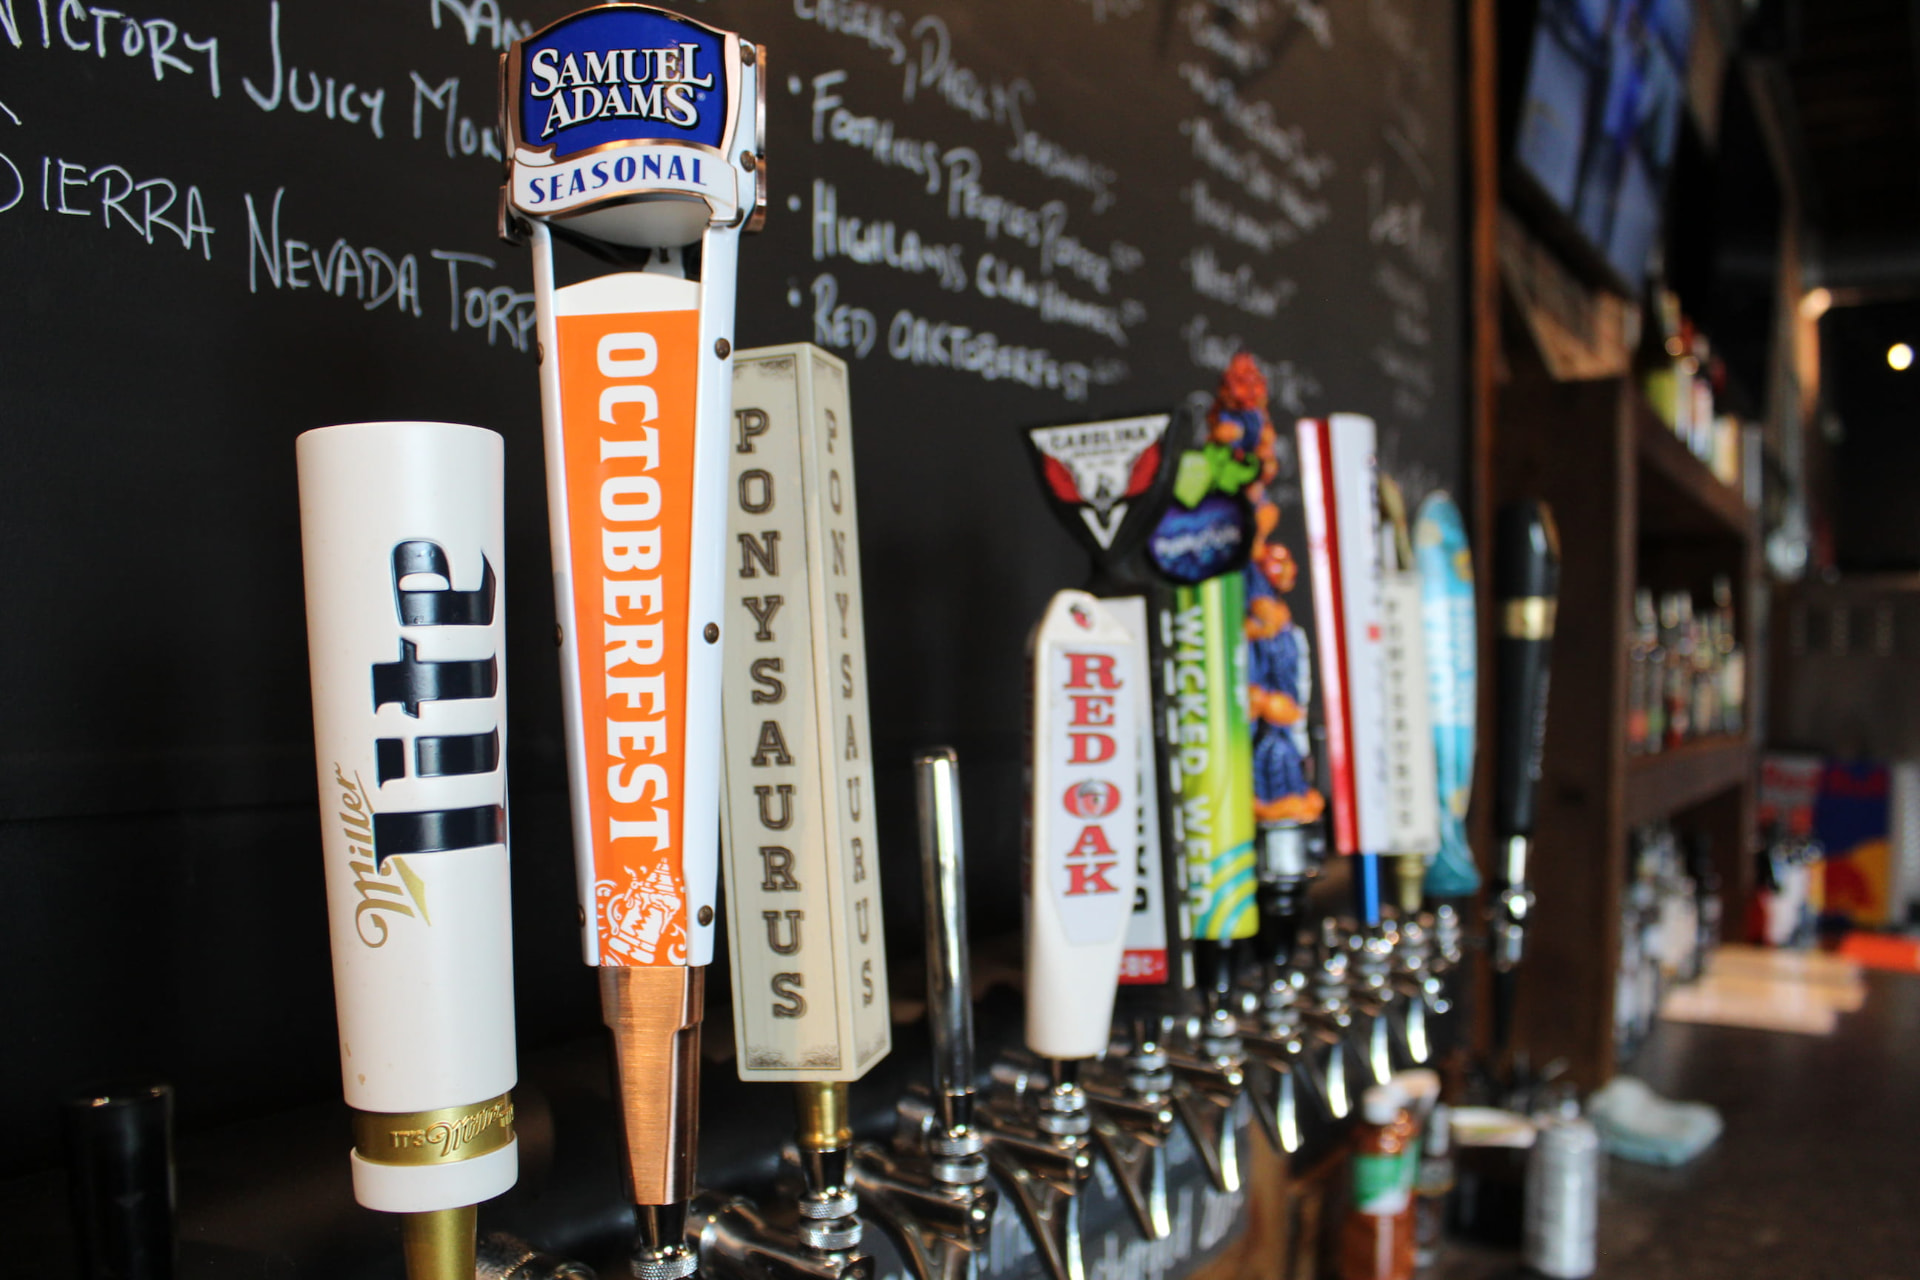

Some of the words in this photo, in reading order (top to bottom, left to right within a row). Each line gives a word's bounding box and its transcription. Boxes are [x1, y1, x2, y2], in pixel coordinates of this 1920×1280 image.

[242, 0, 385, 139] JUICY
[530, 42, 714, 98] SAMUEL
[540, 83, 699, 139] ADAMS
[528, 153, 709, 205] SEASONAL
[244, 186, 423, 317] NEVADA
[597, 331, 670, 853] OCTOBERFEST
[370, 537, 508, 876] lite
[733, 406, 808, 1021] PONYSAURUS
[1062, 652, 1123, 766] RED
[1174, 604, 1210, 776] WICKED
[1061, 777, 1122, 898] OAK
[1184, 793, 1213, 916] WEED
